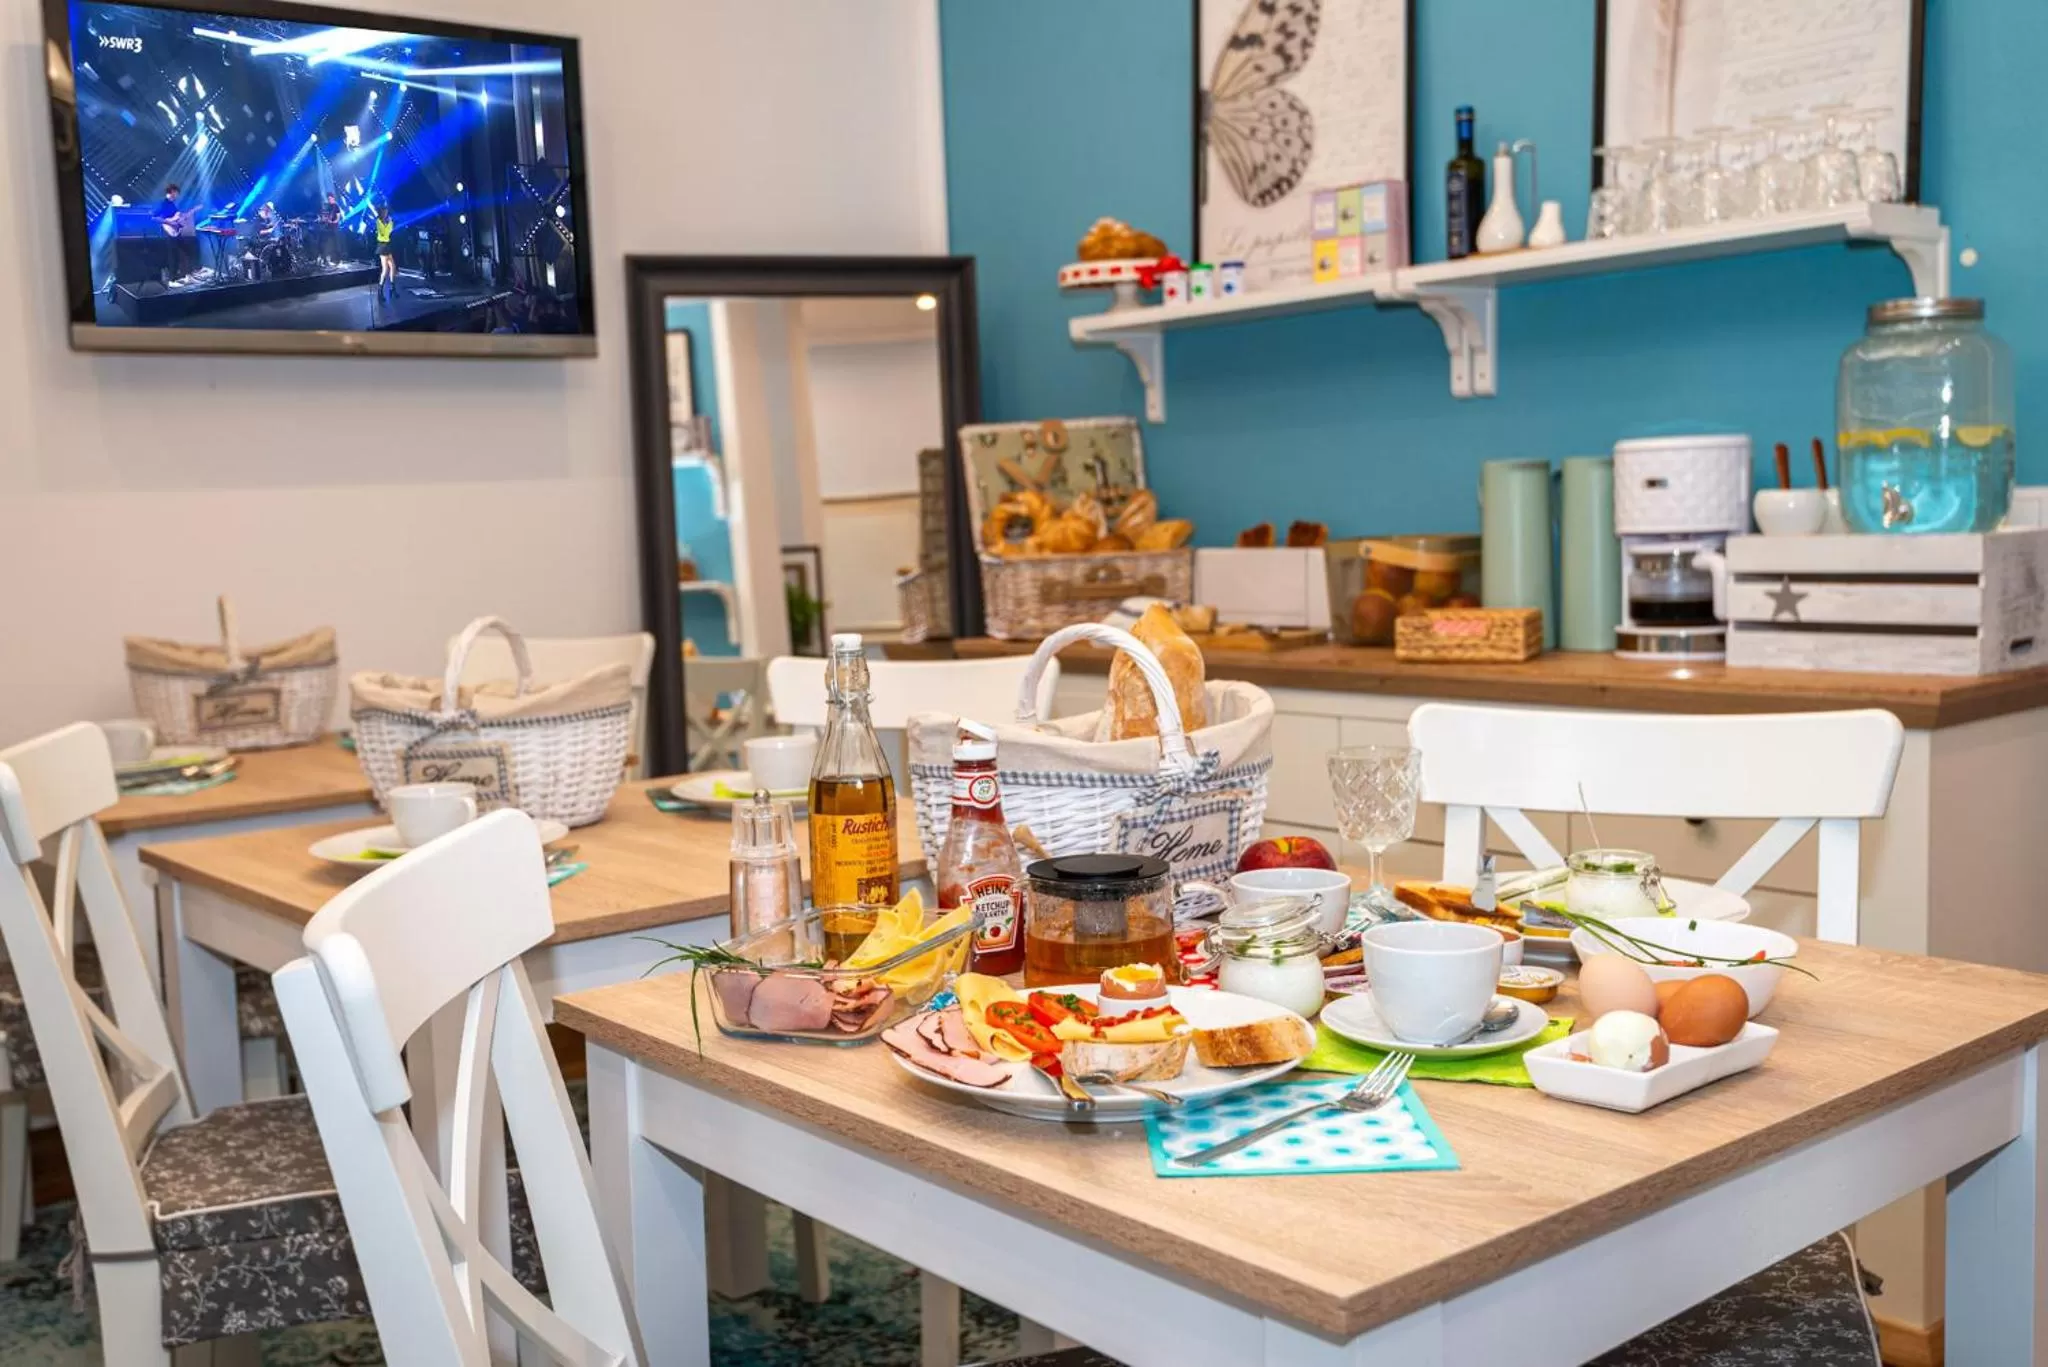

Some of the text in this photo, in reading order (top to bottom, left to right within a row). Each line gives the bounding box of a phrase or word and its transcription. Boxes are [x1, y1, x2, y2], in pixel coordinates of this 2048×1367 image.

[1150, 824, 1224, 863] Home
[976, 882, 1008, 898] HEINZ
[975, 899, 1011, 913] KETCHUP
